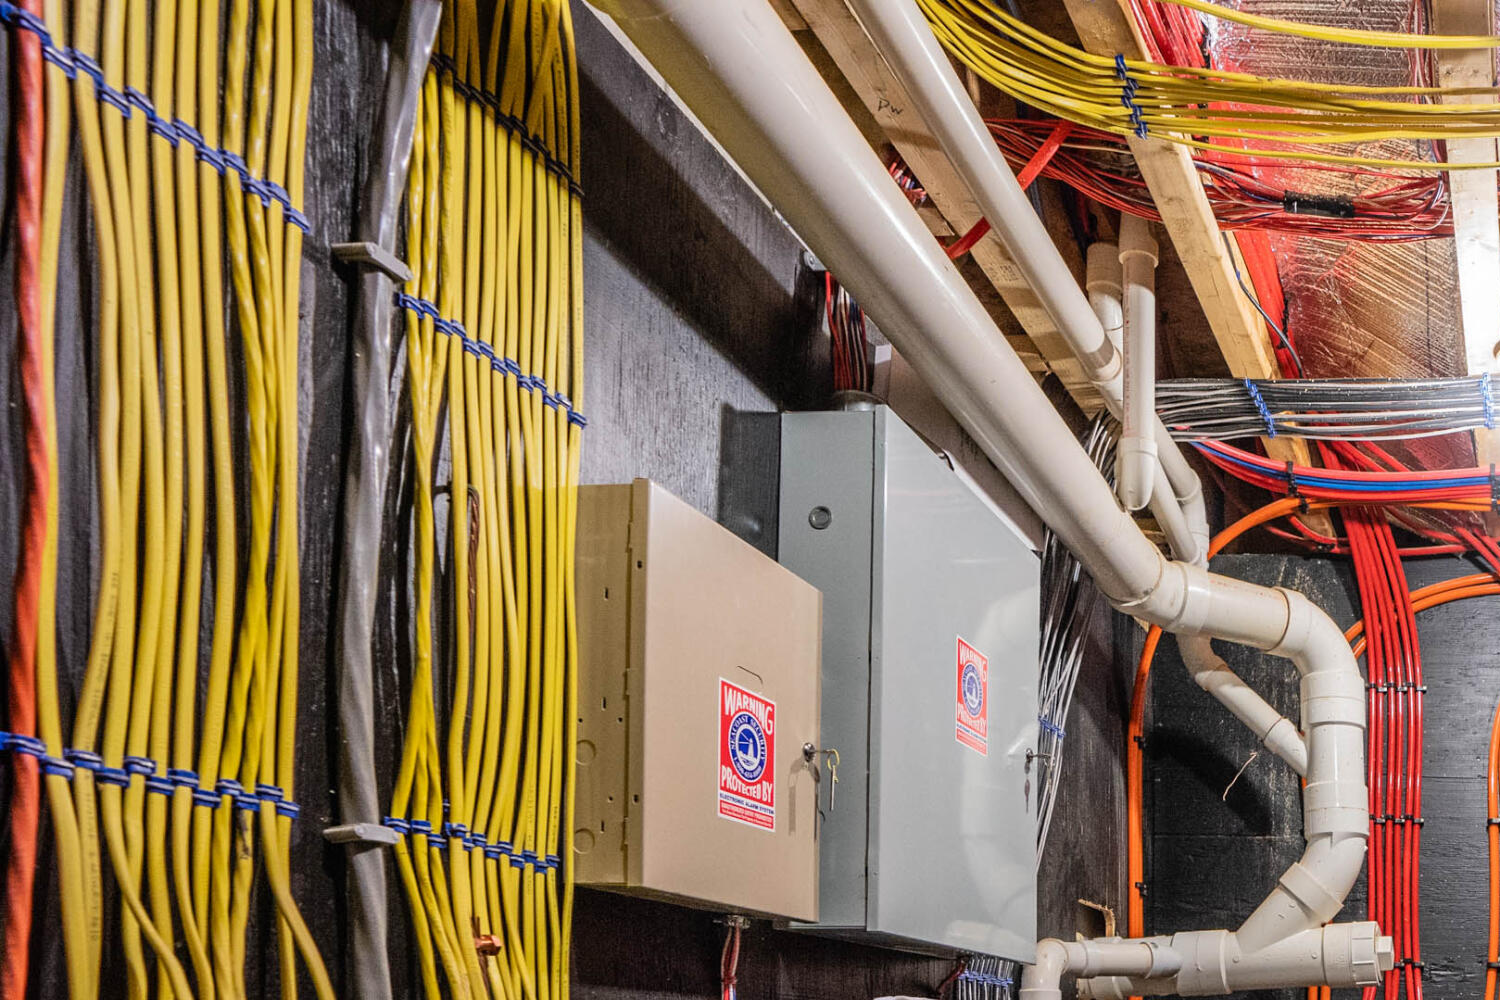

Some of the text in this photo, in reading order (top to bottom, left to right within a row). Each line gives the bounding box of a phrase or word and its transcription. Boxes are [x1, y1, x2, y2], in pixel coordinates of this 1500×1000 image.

[723, 685, 773, 736] WARNING
[730, 715, 767, 761] SEACOAST SECURITY
[721, 765, 762, 800] PROTECTED
[762, 780, 773, 803] BY
